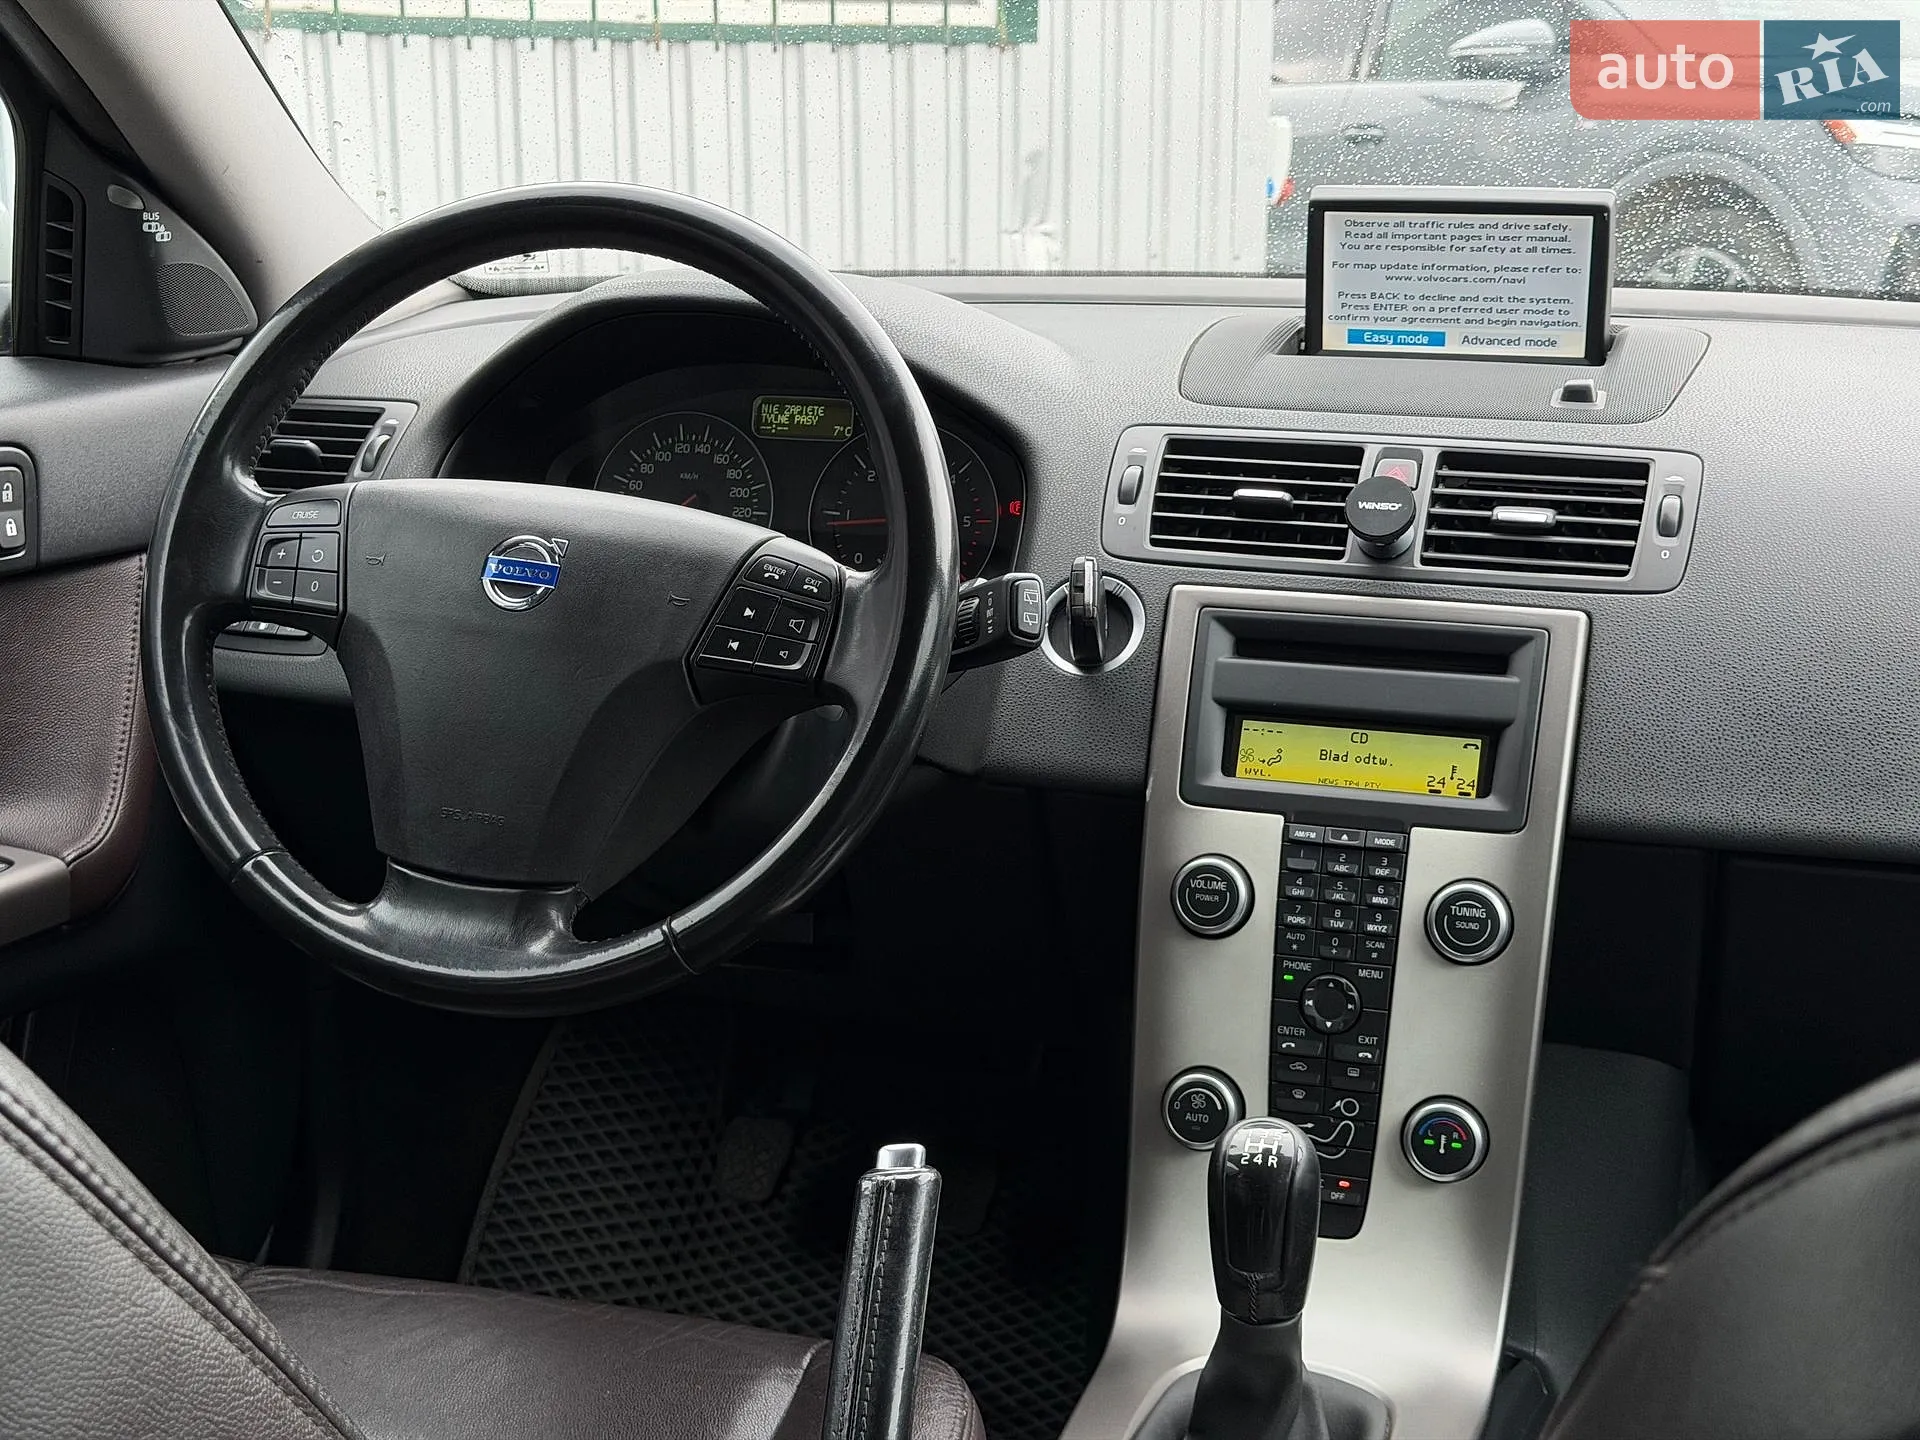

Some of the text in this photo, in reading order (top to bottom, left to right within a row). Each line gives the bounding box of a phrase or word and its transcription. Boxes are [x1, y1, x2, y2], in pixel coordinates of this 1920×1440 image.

[143, 212, 160, 220] BLIS
[1344, 219, 1572, 233] Observe all traffic rules and drive safely.
[1344, 231, 1373, 239] Read
[1376, 232, 1388, 240] all
[1391, 232, 1447, 241] important
[1450, 234, 1482, 242] pages
[1526, 235, 1571, 243] manual.
[1339, 242, 1360, 250] You
[1385, 244, 1446, 252] responsible
[1449, 244, 1466, 252] for
[1469, 245, 1506, 255] safety
[1525, 246, 1538, 254] all
[1541, 246, 1576, 254] times.
[1331, 261, 1350, 269] For
[1353, 263, 1377, 271] map
[1380, 263, 1418, 271] update
[1421, 263, 1490, 273] information,
[1493, 265, 1529, 274] please
[1566, 266, 1582, 274] to:
[1385, 274, 1526, 284] www.volvocars.com/navi
[1337, 291, 1367, 299] Press
[1370, 292, 1401, 300] BACK
[1418, 294, 1456, 302] decline
[1459, 294, 1480, 302] and
[1482, 295, 1504, 303] exit
[1507, 296, 1526, 304] the
[1529, 297, 1574, 305] system.
[1340, 302, 1370, 311] Press
[1373, 303, 1408, 312] ENTER
[1438, 306, 1493, 314] preferred
[1522, 308, 1554, 316] mode
[1327, 313, 1370, 322] confirm
[1400, 316, 1462, 324] agreement
[1487, 318, 1517, 327] begin
[1520, 320, 1582, 328] navigation.
[1363, 332, 1430, 344] Easy mode
[1461, 335, 1558, 348] Advanced mode
[761, 403, 780, 414] NIE
[761, 414, 819, 426] TYLNE PASY
[674, 443, 690, 454] 120
[694, 444, 711, 455] 140
[655, 451, 672, 462] 100
[713, 454, 730, 464] 160
[640, 463, 655, 474] 80
[726, 469, 743, 480] 180
[867, 470, 876, 482] 2
[628, 480, 643, 491] 60
[729, 487, 750, 498] 200
[292, 510, 319, 520] CRUISE
[732, 506, 751, 518] 220
[962, 515, 972, 528] 5
[854, 552, 863, 564] 0
[489, 562, 551, 580] VOLVO
[763, 563, 787, 576] ENTER
[804, 576, 823, 588] EXIT
[1350, 732, 1369, 744] CD
[1319, 748, 1393, 766] Blad odtw.
[1244, 767, 1272, 777] WYL.
[1318, 777, 1340, 786] NEWS
[1364, 781, 1381, 789] PTY
[1426, 776, 1446, 789] 24
[1456, 778, 1476, 791] 24
[1294, 830, 1316, 839] AM/FM
[1374, 838, 1396, 846] MODE
[1339, 853, 1346, 862] 2
[1380, 856, 1388, 866] 3
[1334, 864, 1350, 873] ABC
[1375, 868, 1390, 876] DEF
[1190, 878, 1228, 891] VOLUME
[1296, 877, 1303, 886] 4
[1336, 882, 1344, 890] 5
[1292, 888, 1305, 896] GHI
[1377, 885, 1385, 894] 6
[1195, 893, 1220, 902] POWER
[1332, 892, 1346, 901] JKL
[1372, 896, 1389, 905] MNO
[1295, 904, 1302, 914] 7
[1334, 909, 1342, 918] 8
[1450, 905, 1486, 918] TUNING
[1288, 916, 1306, 924] PQRS
[1375, 912, 1382, 922] 9
[1330, 920, 1344, 928] TUV
[1366, 924, 1388, 933] WXYZ
[1456, 920, 1480, 930] SOUND
[1286, 932, 1306, 942] AUTO
[1332, 937, 1339, 946] 0
[1366, 940, 1386, 950] SCAN
[1283, 960, 1312, 971] PHONE
[1358, 968, 1384, 980] MENU
[1277, 1025, 1306, 1037] ENTER
[1358, 1035, 1379, 1046] EXIT
[1174, 1101, 1180, 1110] 0
[1185, 1112, 1209, 1124] AUTO
[1452, 1132, 1460, 1140] R
[1240, 1152, 1278, 1168] 2 4 R
